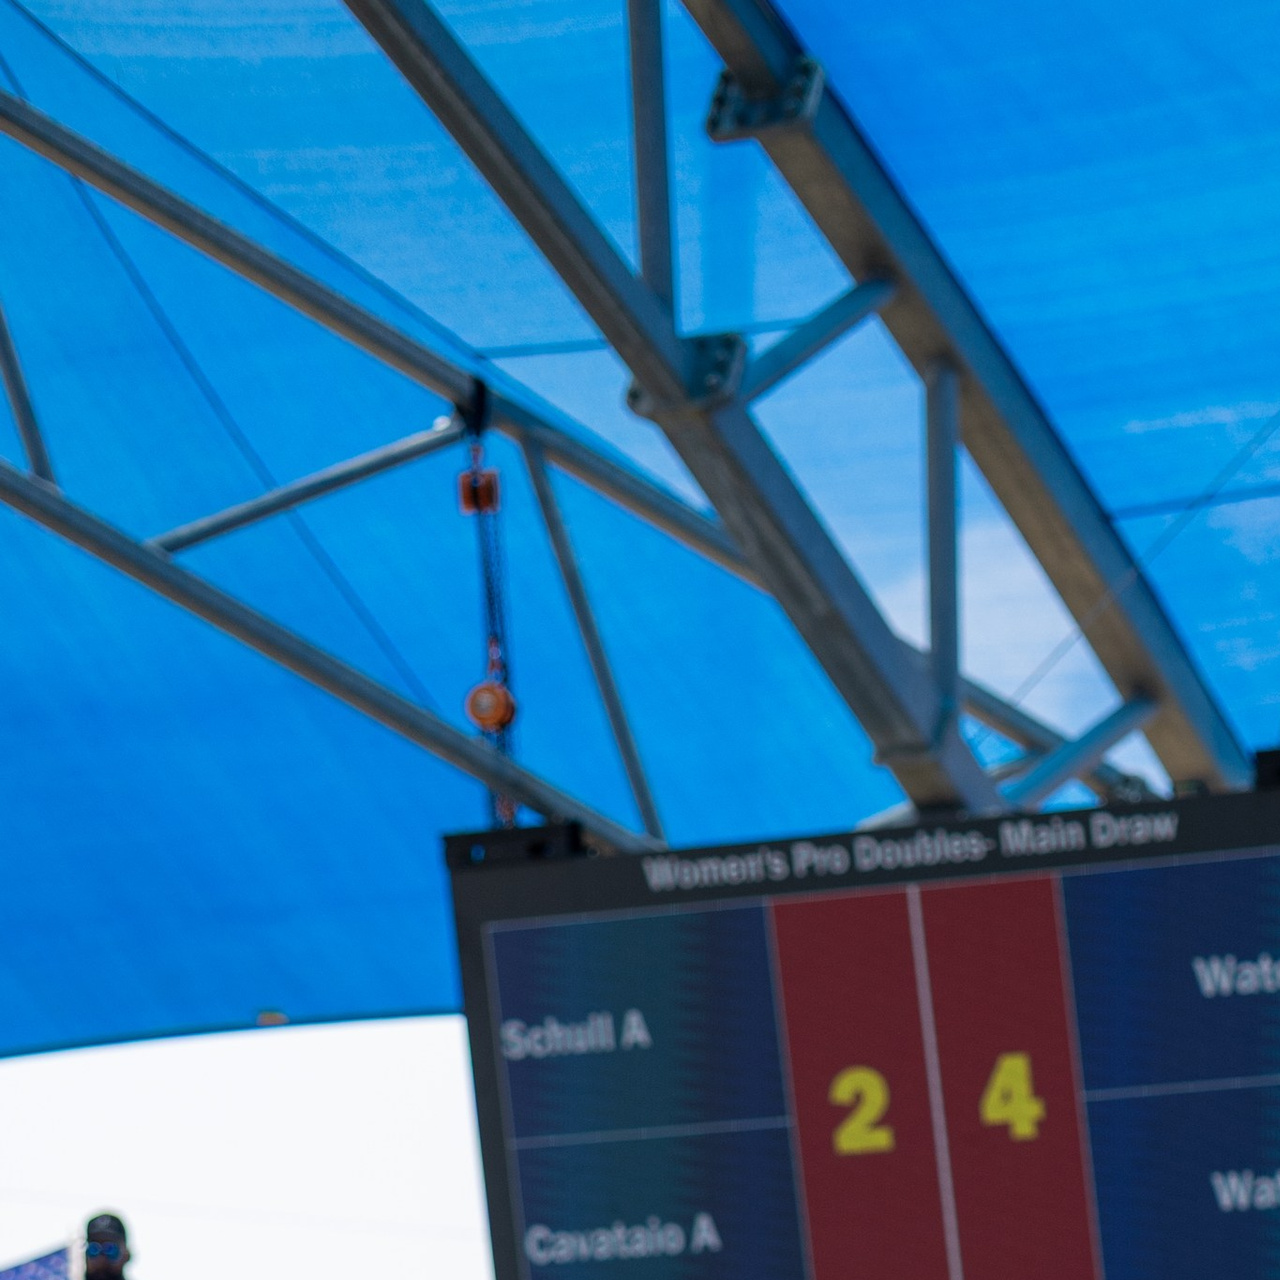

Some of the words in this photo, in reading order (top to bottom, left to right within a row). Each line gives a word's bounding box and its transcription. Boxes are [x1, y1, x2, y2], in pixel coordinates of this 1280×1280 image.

[643, 851, 789, 890] Women's
[793, 841, 850, 877] Pro
[853, 828, 996, 872] Doubles-
[1000, 816, 1086, 857] Main
[1090, 811, 1179, 848] Draw
[501, 1010, 616, 1061] Schull
[620, 1008, 654, 1049] A
[828, 1064, 896, 1156] 2
[978, 1050, 1047, 1143] 4
[524, 1217, 686, 1268] Cavataio
[690, 1212, 722, 1253] A
